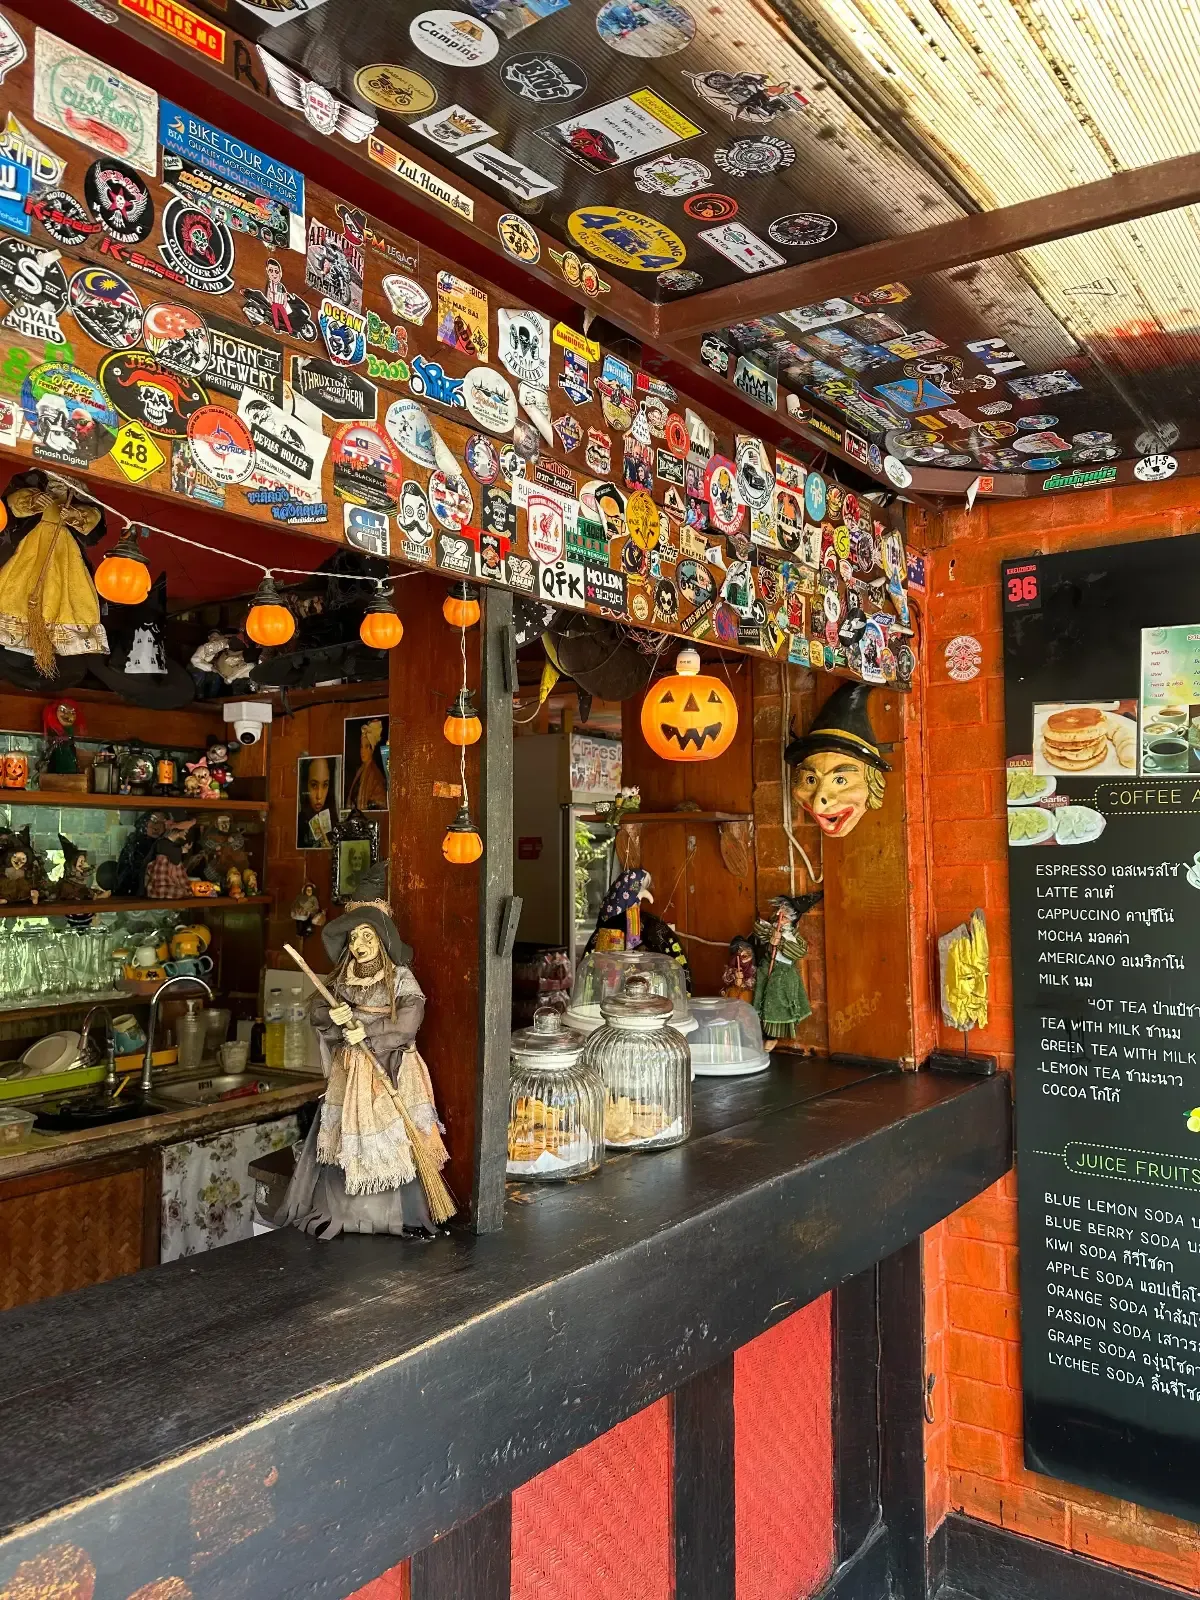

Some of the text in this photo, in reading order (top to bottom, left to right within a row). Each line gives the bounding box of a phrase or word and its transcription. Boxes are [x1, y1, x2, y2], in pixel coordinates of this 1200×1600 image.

[130, 0, 193, 36] IABLOS
[196, 27, 217, 50] MC
[418, 20, 480, 61] Camping
[188, 119, 297, 190] BIKE TOUR ASIA
[713, 148, 747, 178] KEEPERS
[761, 135, 796, 167] BROTHERS
[179, 170, 212, 193] 1000
[189, 140, 297, 202] QUALITY MOTORCYCLE TOURS
[0, 210, 24, 226] ehicle
[615, 210, 683, 258] PORT KLANG
[168, 238, 226, 278] OUTSIDER MC
[386, 244, 418, 269] LEGACY
[471, 287, 488, 302] RIDE
[324, 301, 364, 333] OCEAN
[213, 334, 258, 369] HORN
[206, 353, 277, 392] BREWERY
[326, 385, 364, 413] NORTHERN
[736, 377, 774, 407] RIDER
[34, 447, 89, 467] Smash Digital
[121, 440, 149, 465] 48
[215, 443, 247, 456] JOYRIDE
[280, 447, 310, 473] HOLLER
[1007, 575, 1038, 602] 36
[1040, 795, 1068, 804] Garlic
[1109, 789, 1183, 805] COFFEE
[1036, 864, 1107, 877] ESPRESSO
[1036, 887, 1079, 899] LATTE
[1037, 908, 1121, 922] CAPPUCCINO
[1037, 930, 1083, 943] MOCHA
[1038, 952, 1116, 967] AMERICANO
[1039, 973, 1094, 988] MILK นม
[1119, 1000, 1148, 1014] TEA
[1040, 1017, 1066, 1031] TEA
[1071, 1019, 1103, 1033] WITH
[1108, 1022, 1141, 1037] MILK
[1041, 1038, 1197, 1065] GREEN TEA WITH MILK
[1094, 1066, 1121, 1081] TEA
[1042, 1083, 1087, 1099] COCOA
[1076, 1153, 1200, 1185] JUICE FRUITS
[1044, 1192, 1082, 1210] BLUE
[1087, 1199, 1139, 1219] LEMON
[1144, 1208, 1185, 1228] SODA
[1045, 1215, 1082, 1232] BLUE
[1088, 1222, 1134, 1241] BERRY
[1140, 1231, 1181, 1251] SODA
[1045, 1237, 1074, 1253] KIWI
[1079, 1243, 1118, 1263] SODA
[1046, 1261, 1135, 1290] APPLE SODA
[1047, 1282, 1104, 1307] ORANGE
[1109, 1296, 1149, 1317] SODA
[1047, 1305, 1107, 1331] PASSION
[1112, 1321, 1152, 1342] SODA
[1047, 1328, 1137, 1363] GRAPE SODA
[1048, 1352, 1146, 1389] LYCHEE SODA
